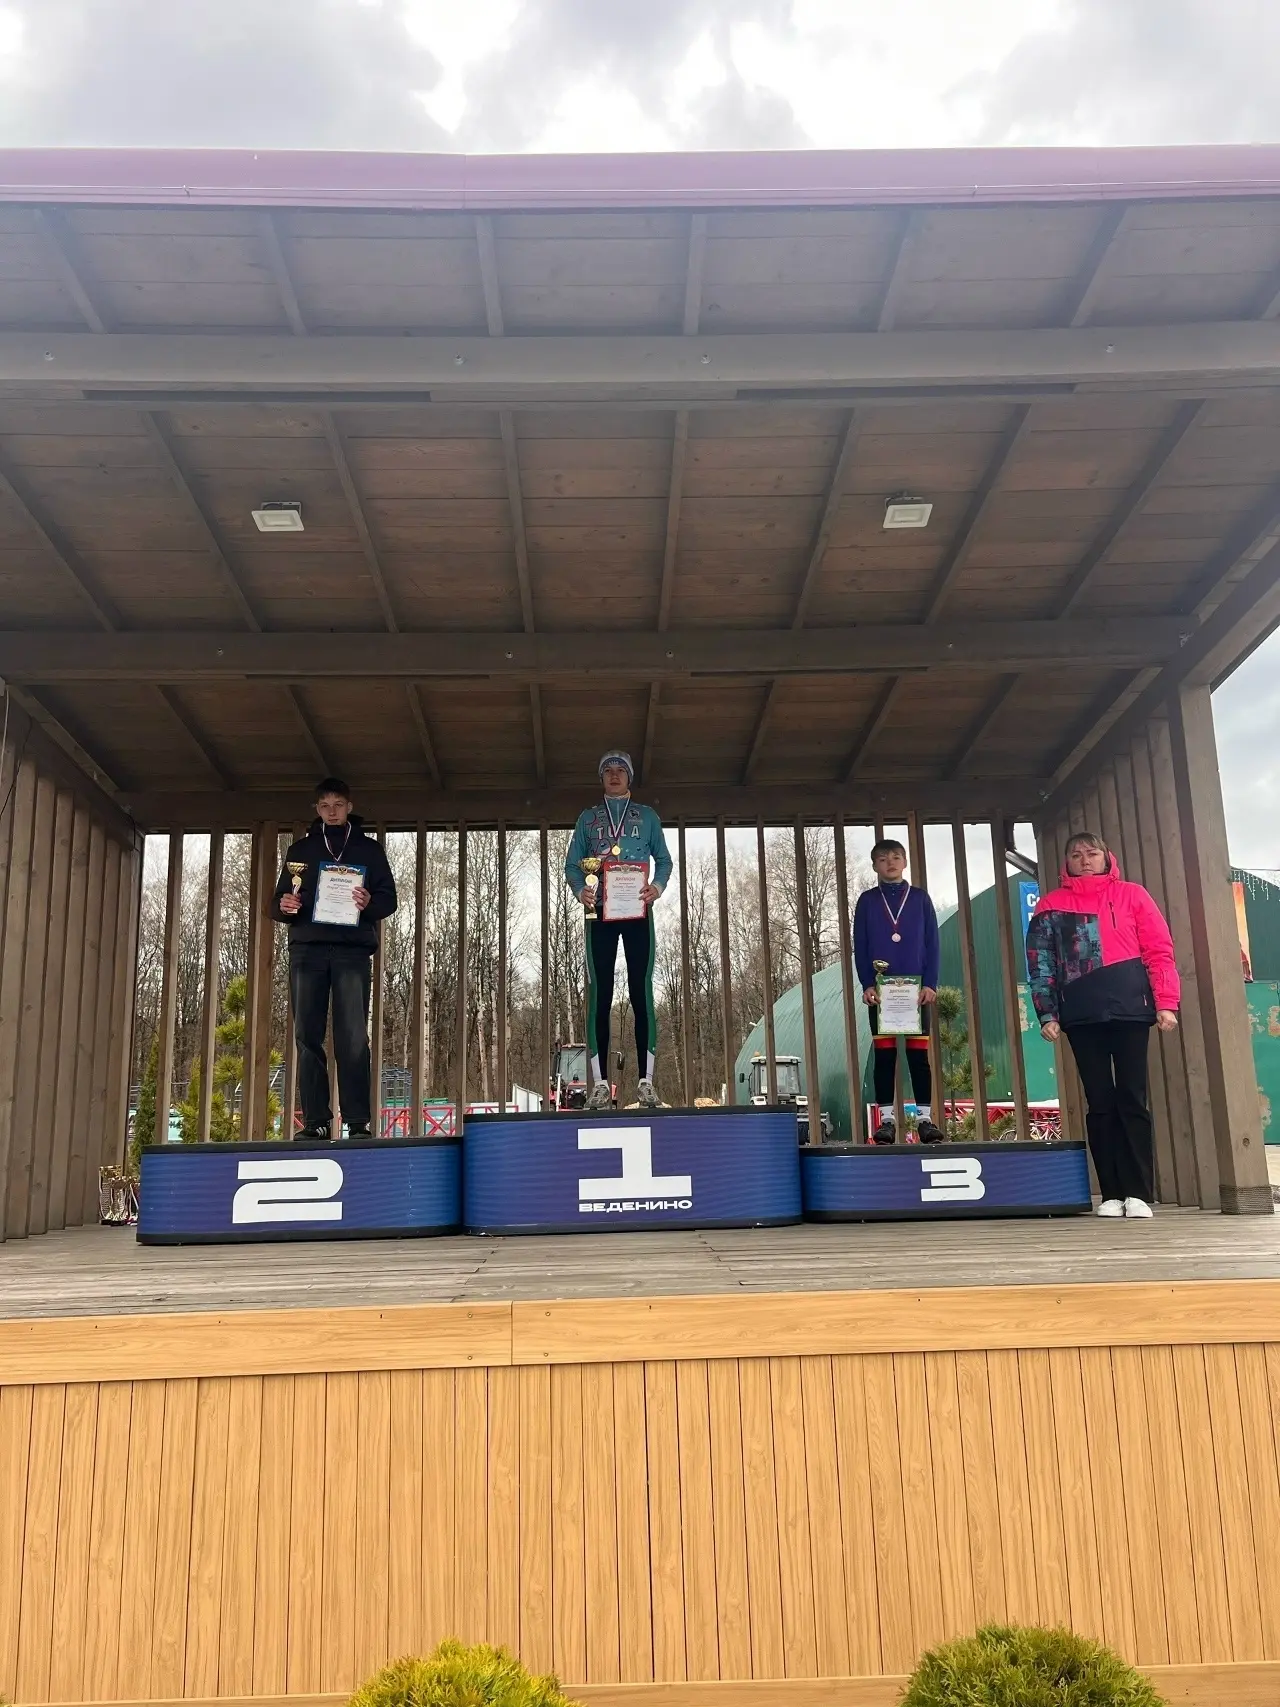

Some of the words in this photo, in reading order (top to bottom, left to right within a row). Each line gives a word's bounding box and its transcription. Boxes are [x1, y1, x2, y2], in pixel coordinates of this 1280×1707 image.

[578, 1127, 692, 1200] 1
[921, 1157, 986, 1202] 3
[232, 1159, 344, 1223] 2
[579, 1200, 693, 1213] ВЕДЕНИНО
